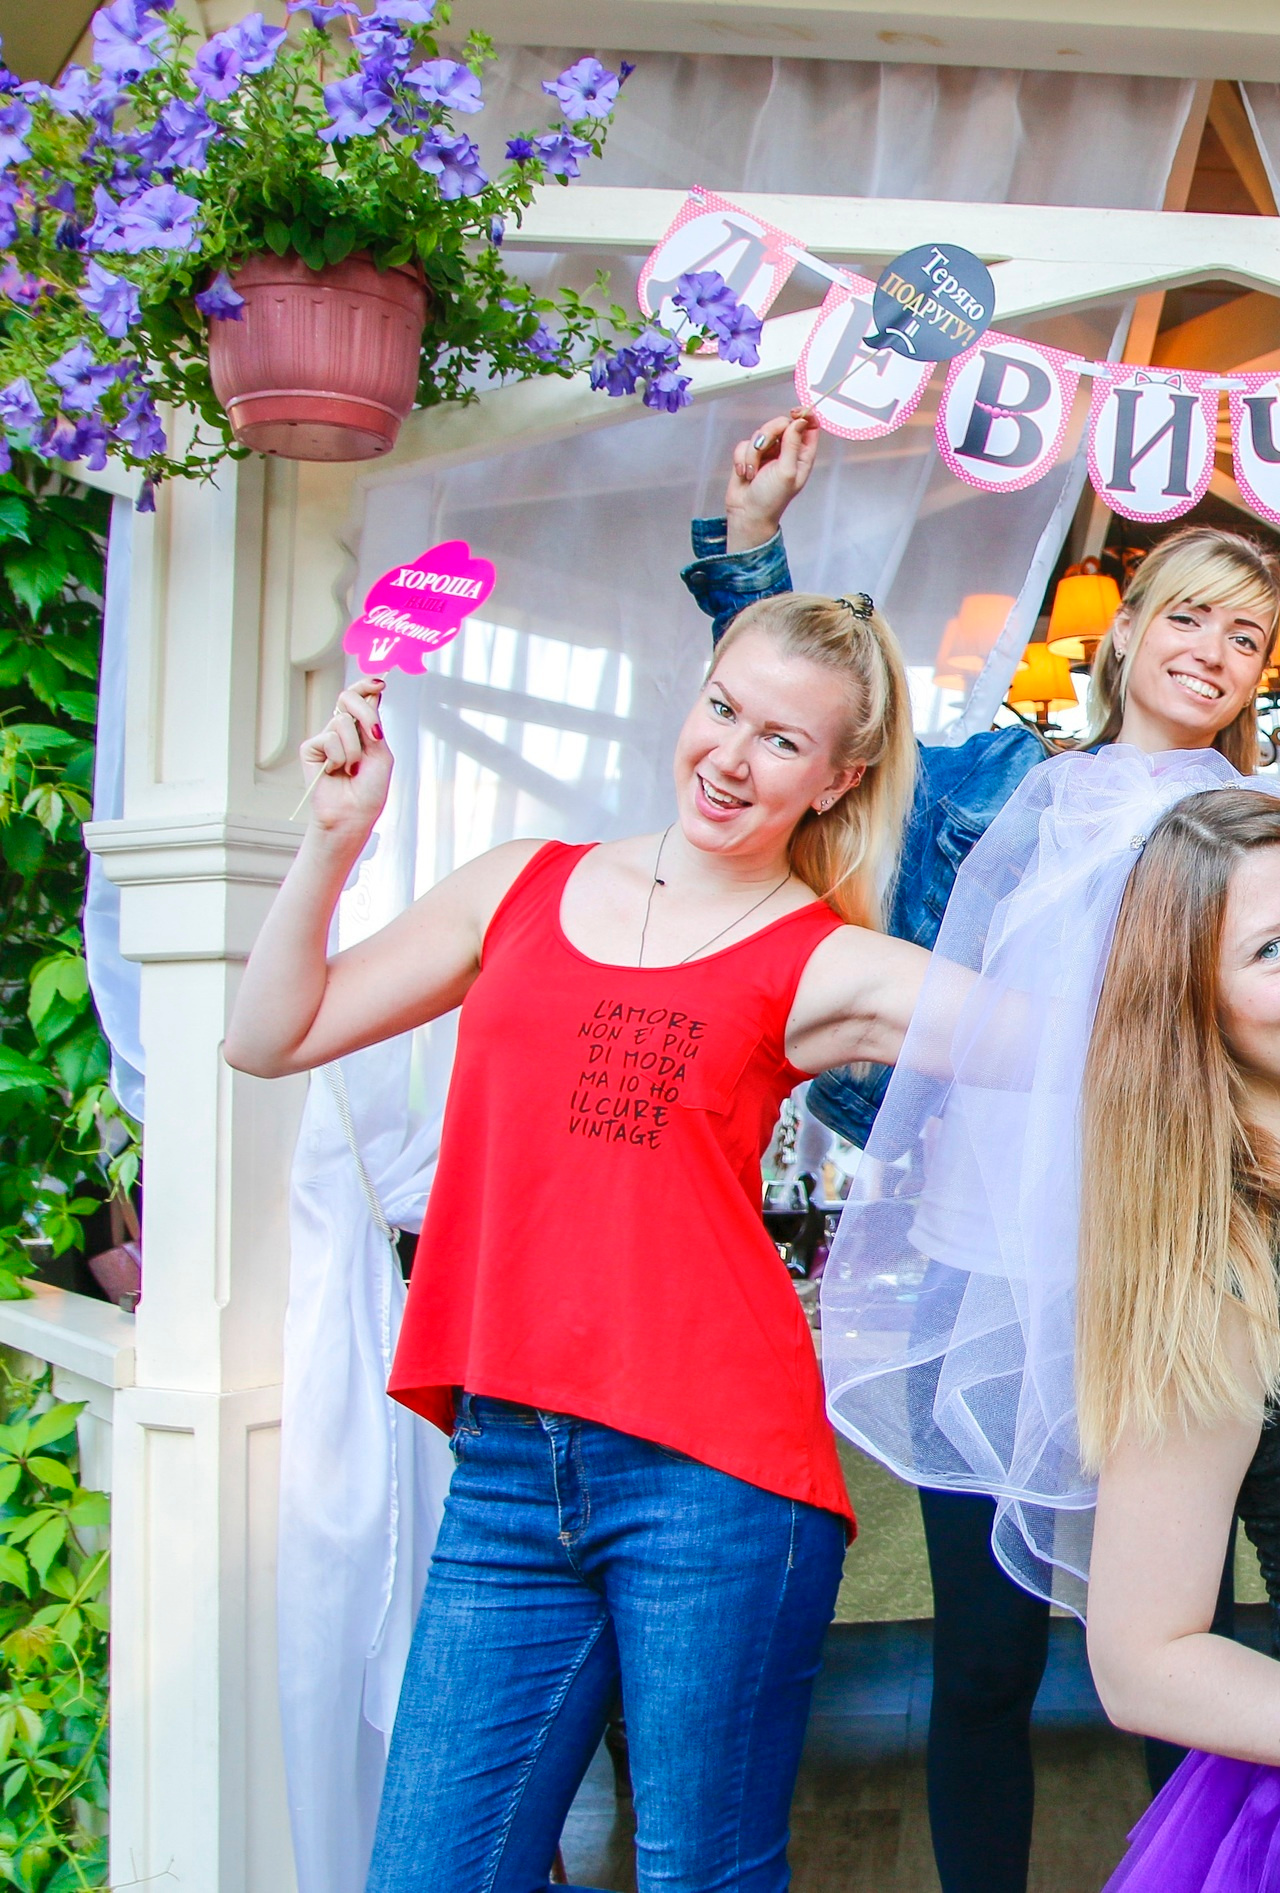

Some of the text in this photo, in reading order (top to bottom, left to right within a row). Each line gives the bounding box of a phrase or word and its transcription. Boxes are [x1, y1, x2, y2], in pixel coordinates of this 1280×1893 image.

[921, 246, 985, 321] Теряю
[880, 271, 976, 347] ПОДРУГУ!
[389, 568, 483, 599] ХОРОША
[363, 605, 457, 645] Невеста!
[577, 1022, 623, 1041] NON
[594, 1000, 708, 1039] L'AMORE
[588, 1044, 686, 1083] DI MODA
[579, 1071, 608, 1089] MA
[650, 1080, 679, 1103] HO
[569, 1116, 662, 1150] VINTAGE
